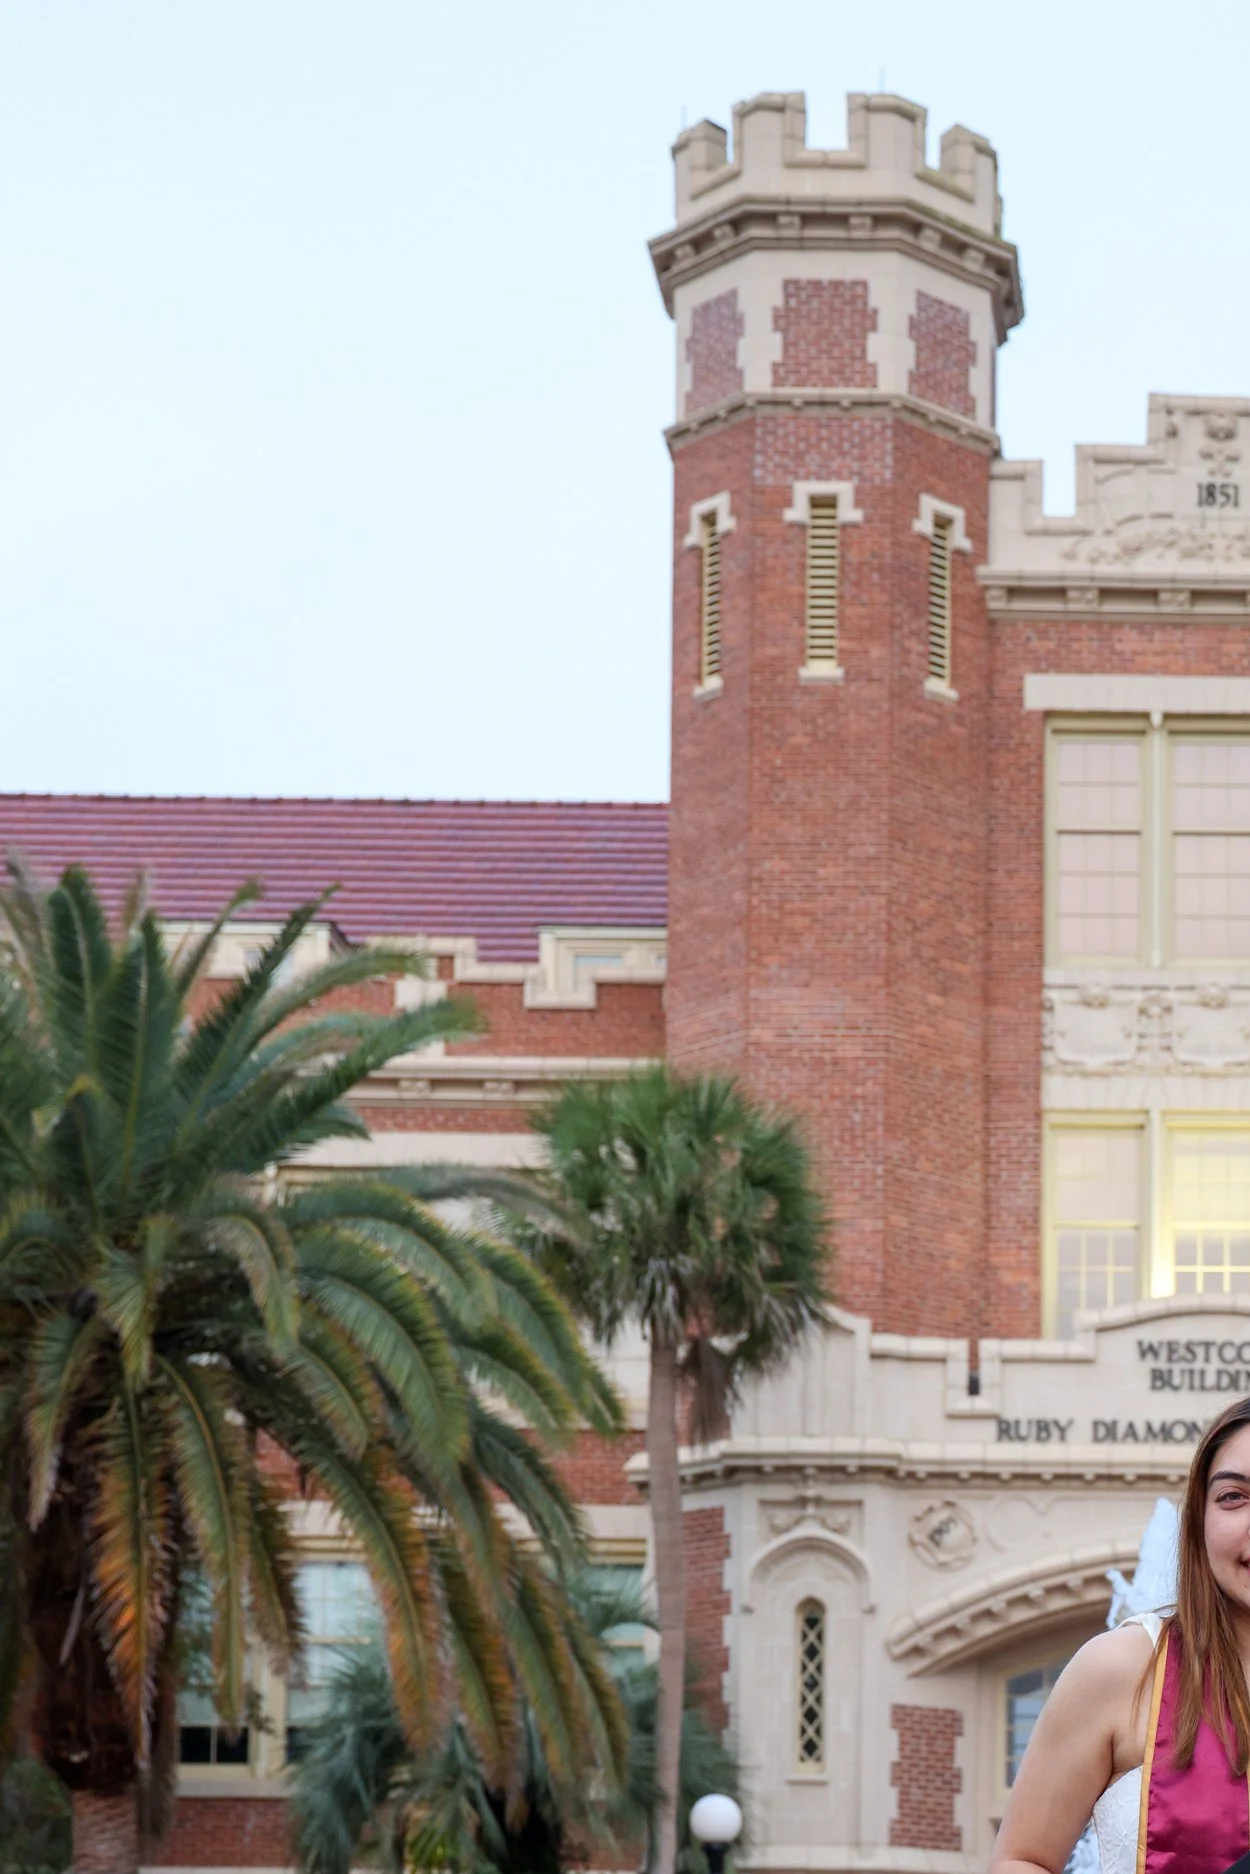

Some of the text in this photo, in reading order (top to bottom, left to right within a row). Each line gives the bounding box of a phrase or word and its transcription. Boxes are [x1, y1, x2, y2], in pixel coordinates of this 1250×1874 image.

[1196, 482, 1240, 509] 1851
[996, 1417, 1074, 1444] RUBY
[1091, 1418, 1205, 1444] DIAMON
